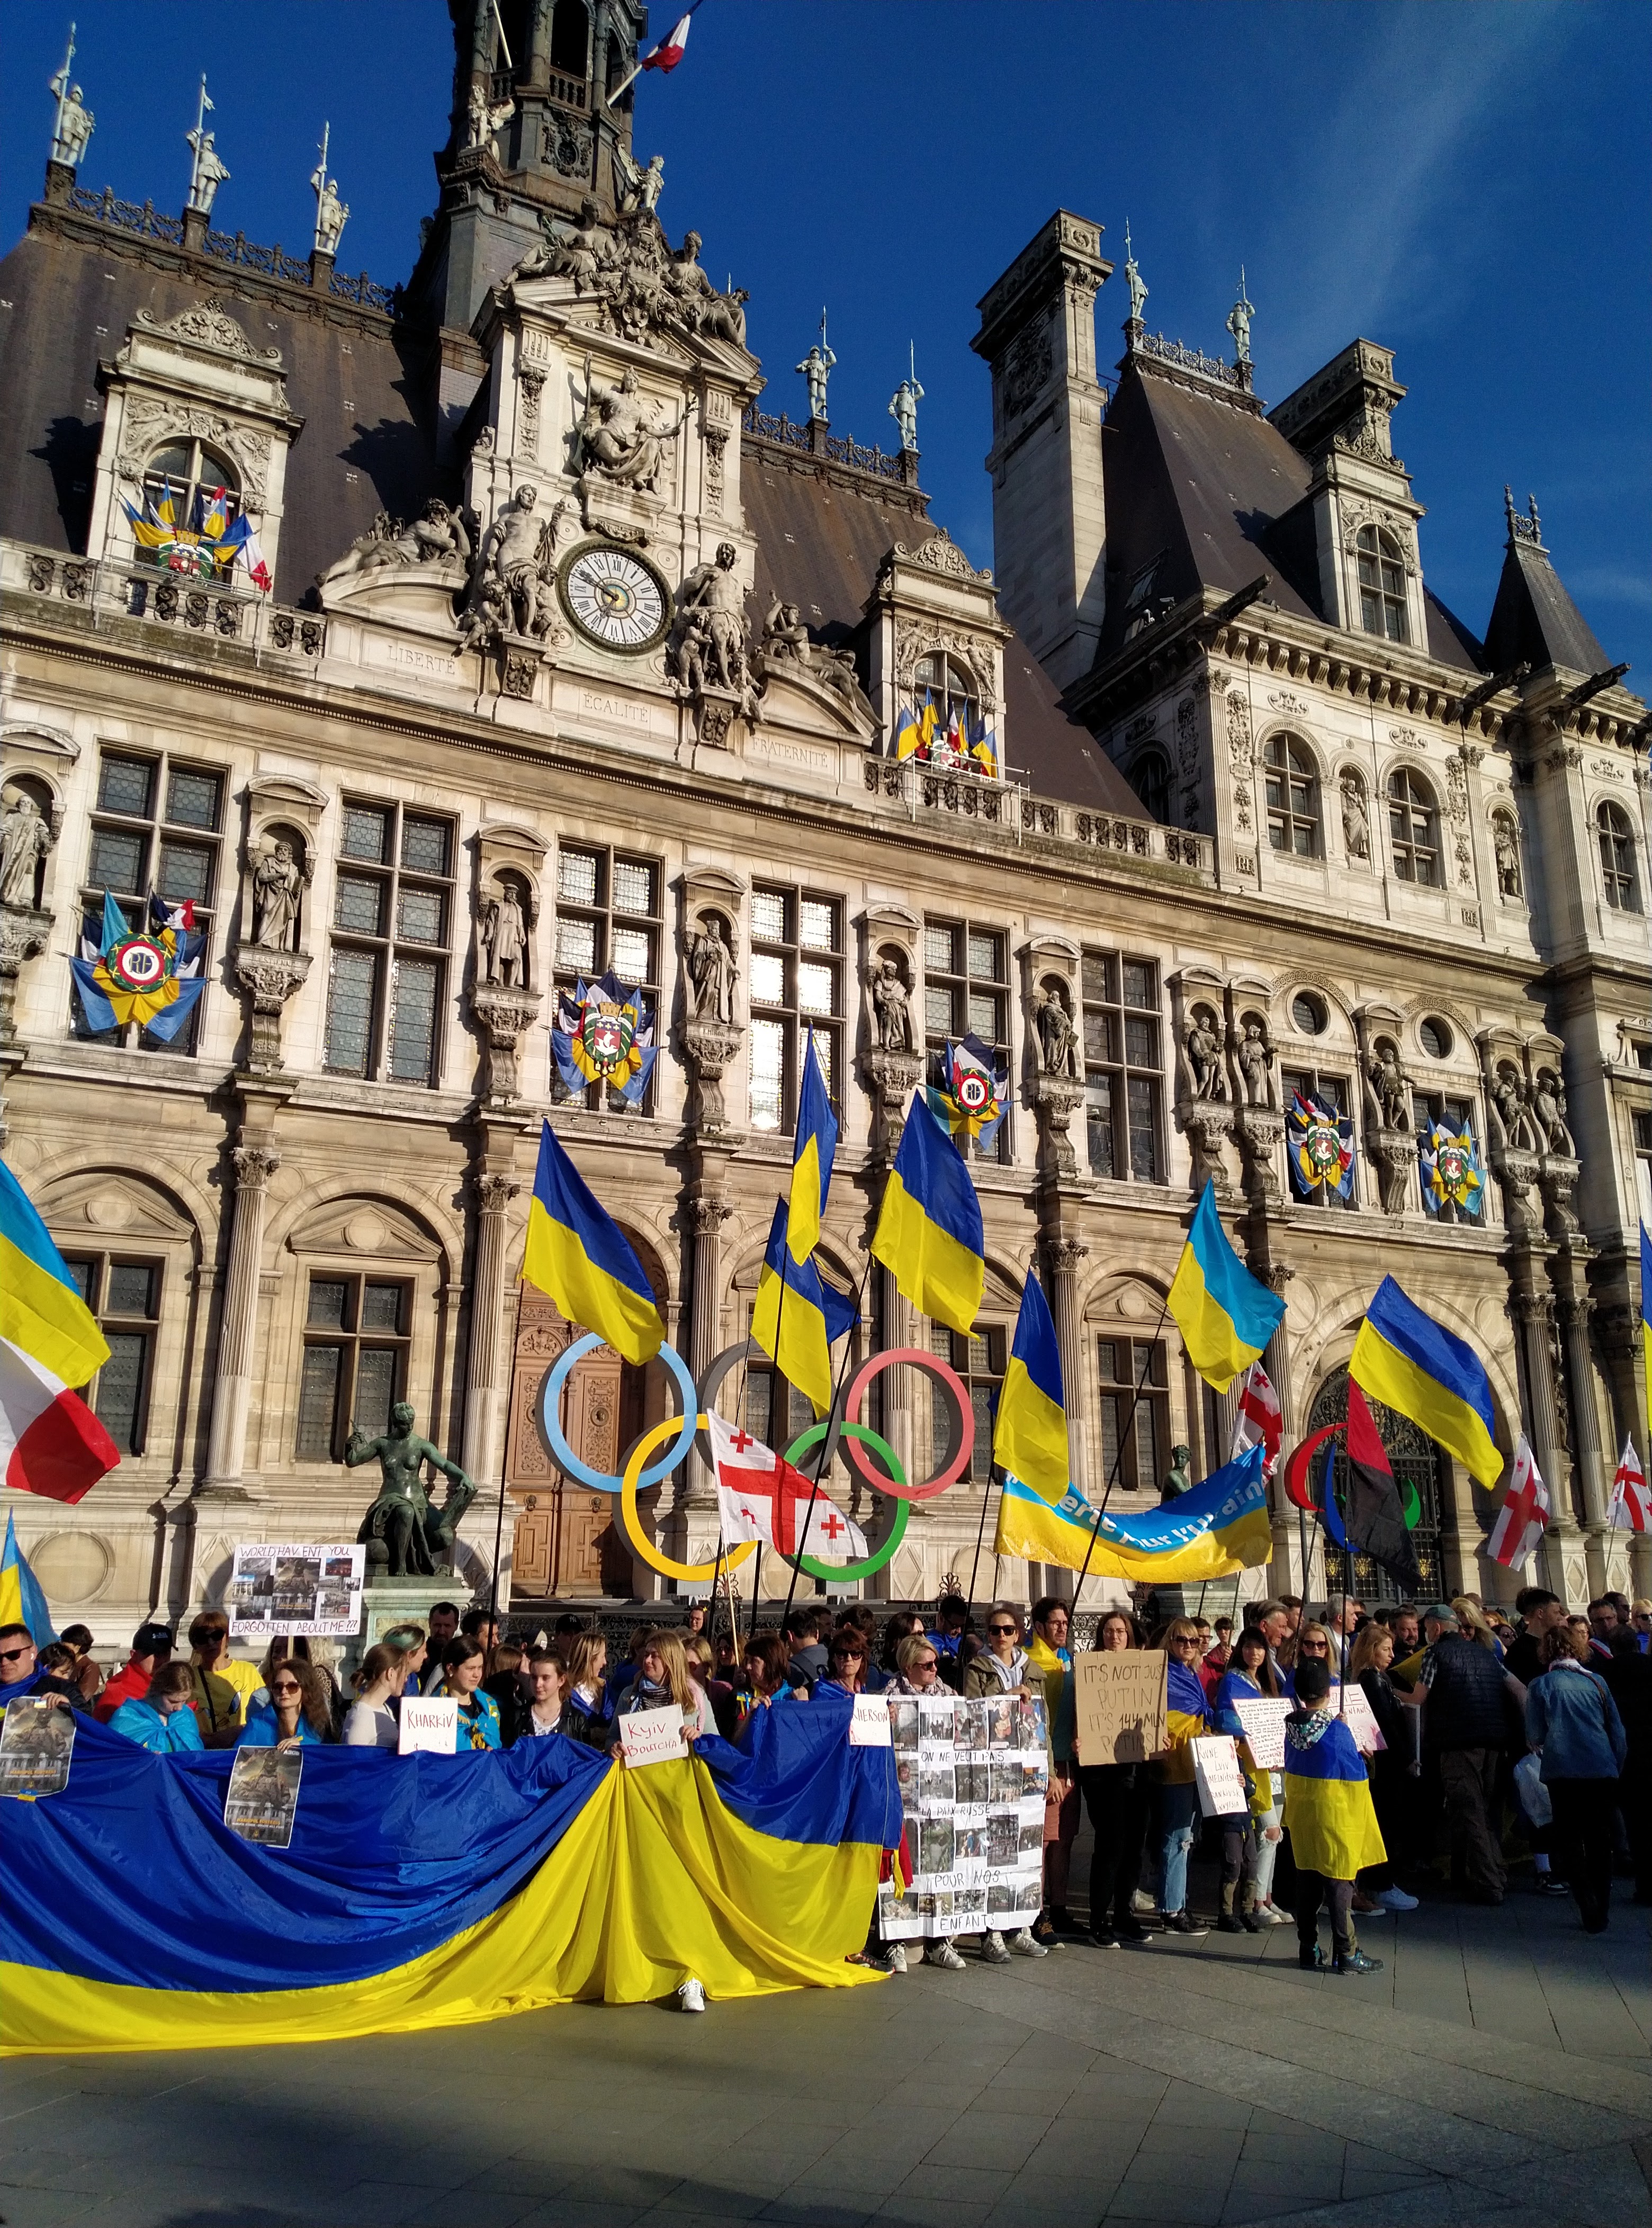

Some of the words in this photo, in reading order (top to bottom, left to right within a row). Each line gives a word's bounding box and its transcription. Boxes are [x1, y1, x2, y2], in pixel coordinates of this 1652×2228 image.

[594, 559, 605, 571] XI
[613, 559, 621, 572] XII
[388, 645, 455, 675] LIBERTÉ
[752, 736, 828, 768] FRATERNITÉ
[129, 951, 155, 974] RF
[966, 1083, 982, 1100] RF
[328, 1546, 349, 1556] YOU
[231, 1621, 289, 1633] FORGOTTEN
[296, 1622, 329, 1633] ABOUT
[1084, 1663, 1109, 1684] IT'S
[1112, 1665, 1141, 1681] NOT
[1097, 1687, 1153, 1710] PUTIN
[1089, 1712, 1114, 1732] IT'S
[1119, 1713, 1140, 1730] 144
[1143, 1712, 1166, 1728] MLN
[627, 1740, 677, 1757] BOUTCHA
[1100, 1732, 1154, 1754] PUTINS
[921, 1751, 934, 1762] ON
[955, 1751, 978, 1762] VEUT
[982, 1751, 1004, 1762] PAS
[937, 1806, 956, 1816] PAIX
[960, 1803, 991, 1816] RUSSE
[935, 1873, 964, 1888] POUR
[974, 1869, 1000, 1884] NOS
[940, 1913, 994, 1931] ENFANTS
